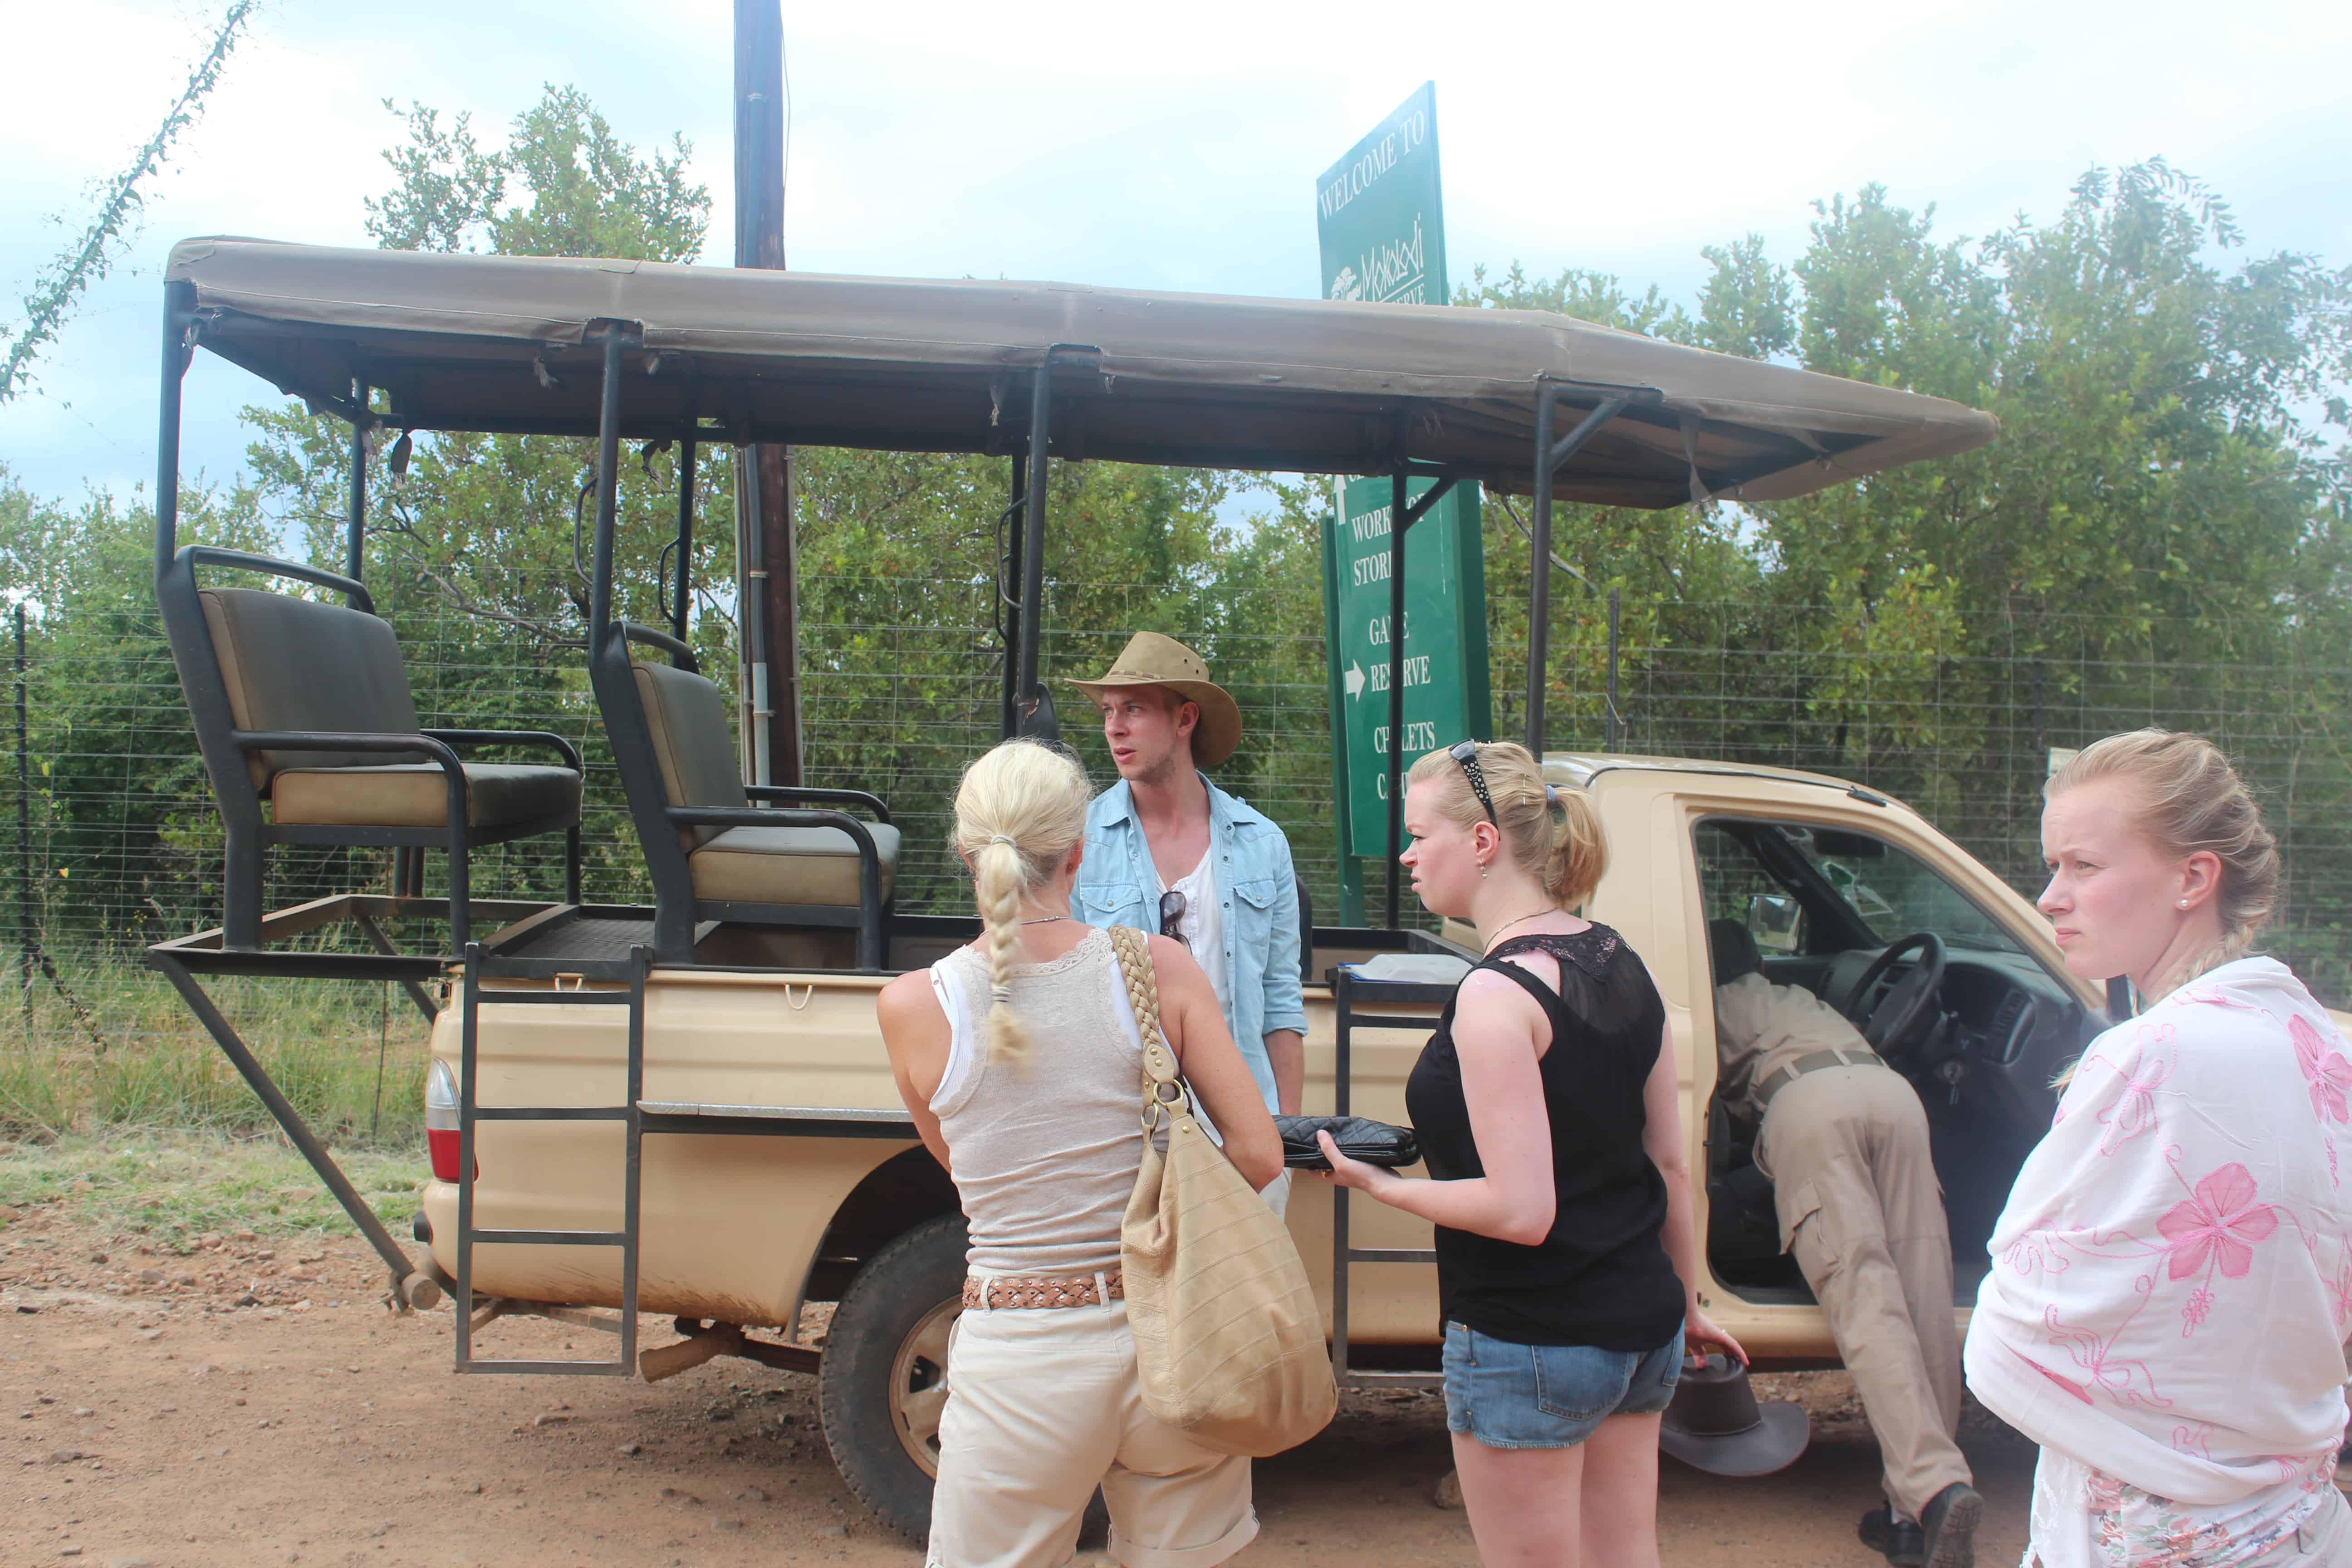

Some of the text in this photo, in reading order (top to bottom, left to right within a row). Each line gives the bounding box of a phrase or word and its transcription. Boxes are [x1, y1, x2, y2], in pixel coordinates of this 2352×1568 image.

[1320, 110, 1425, 221] WELCOME TO
[1374, 721, 1436, 754] CHLETS
